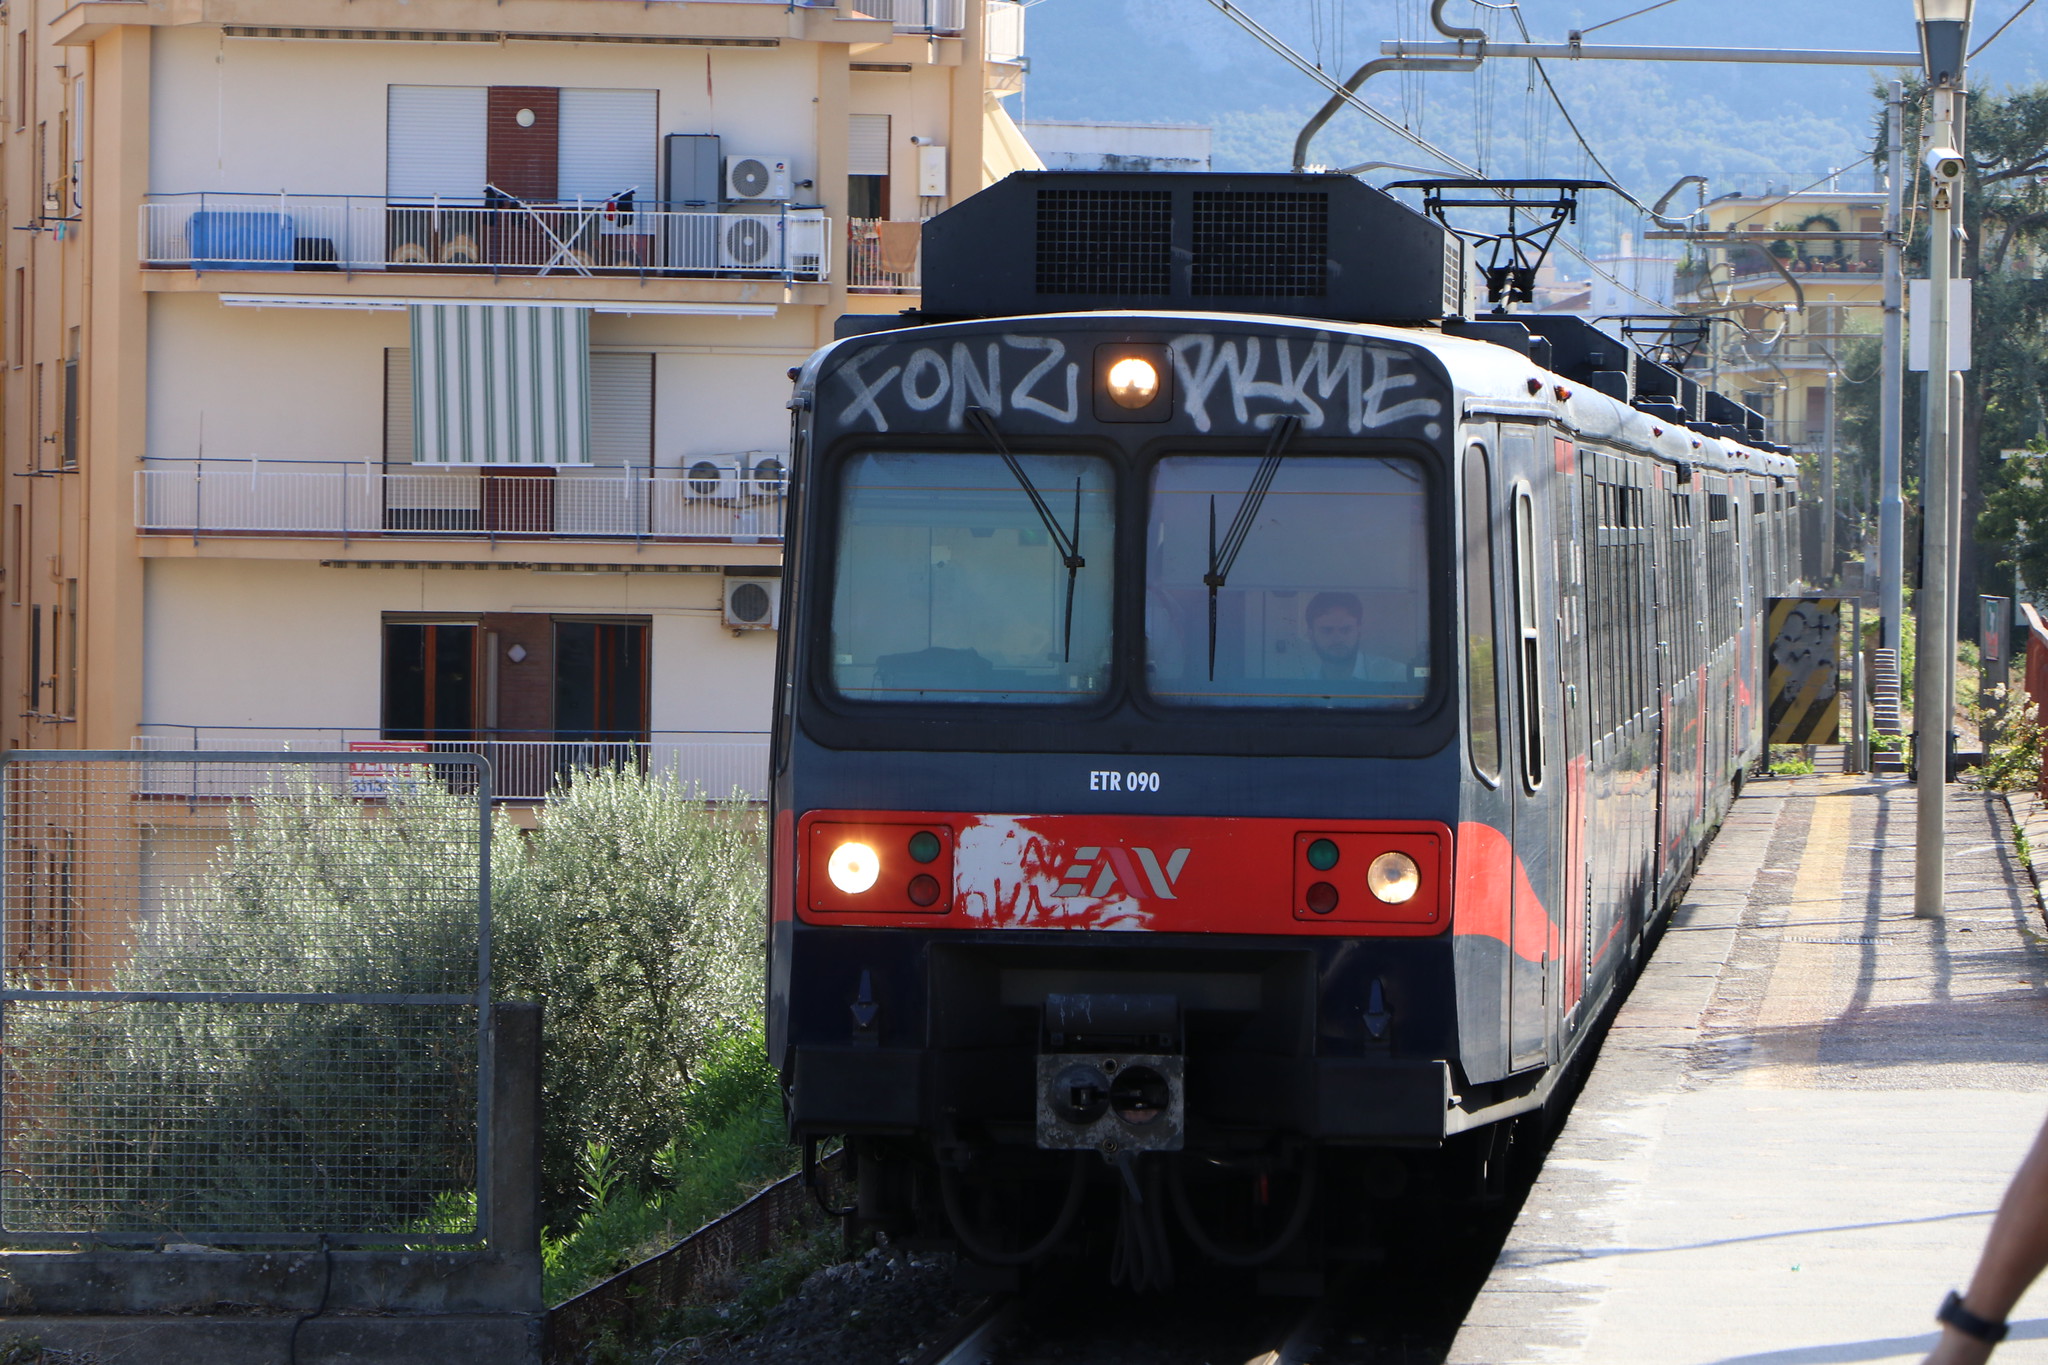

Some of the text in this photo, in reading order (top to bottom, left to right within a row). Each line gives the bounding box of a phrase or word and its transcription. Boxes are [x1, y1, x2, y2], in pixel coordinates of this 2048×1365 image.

[1090, 771, 1160, 792] ETR 090
[1050, 846, 1191, 899] EAV
